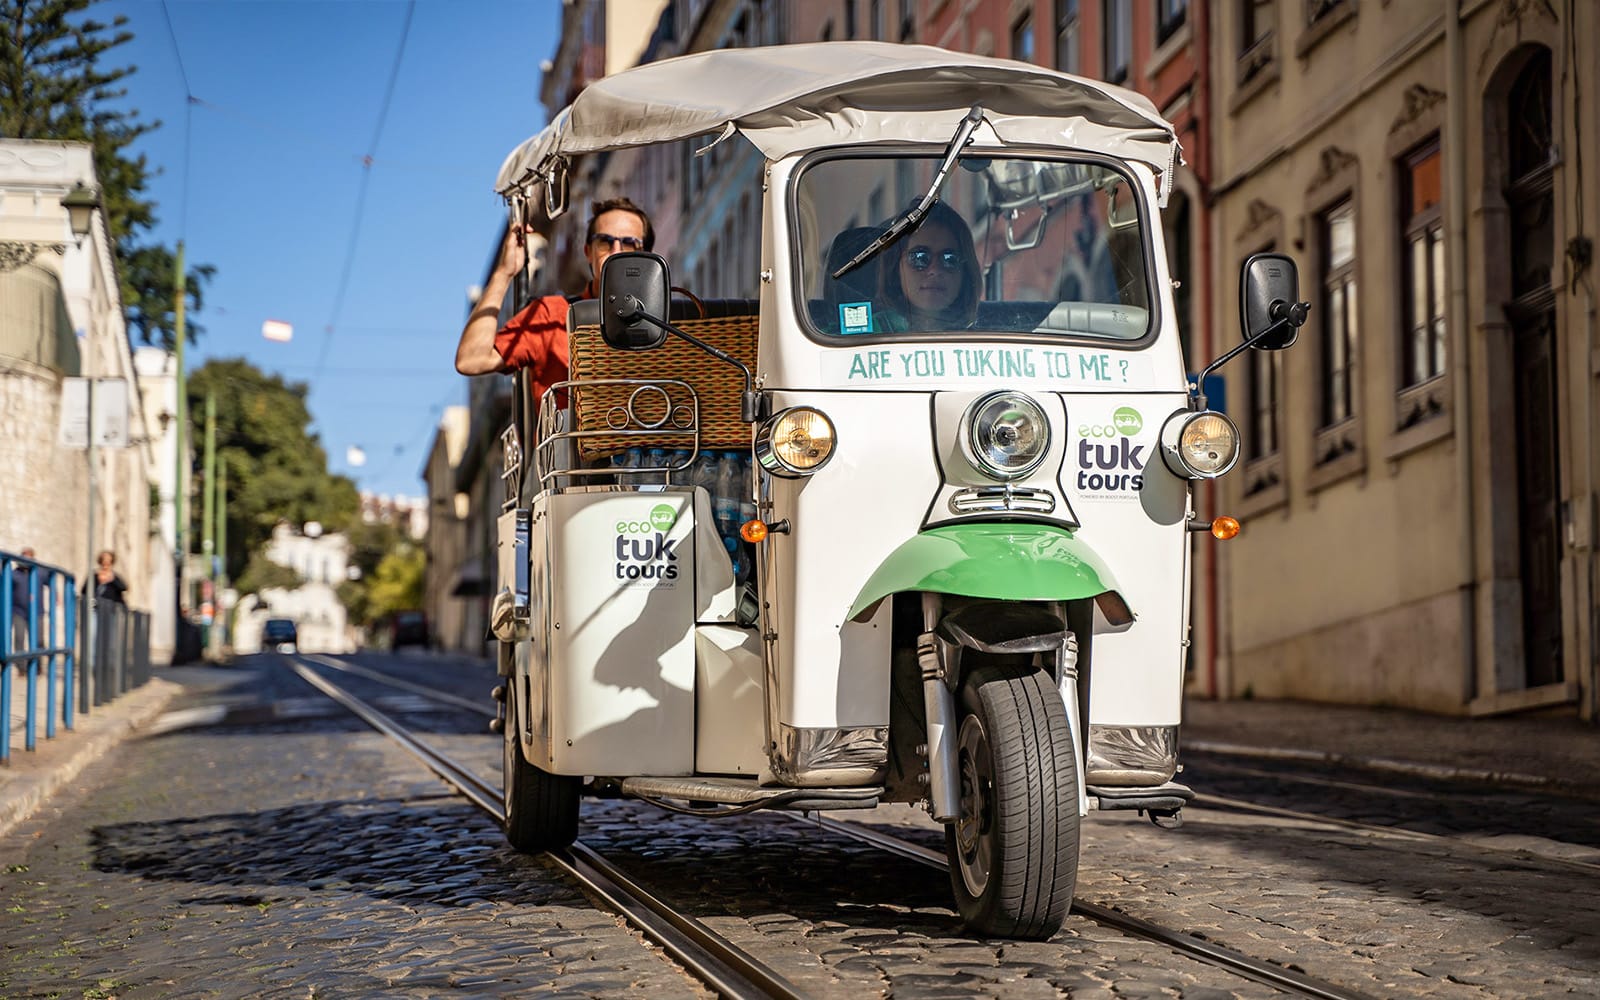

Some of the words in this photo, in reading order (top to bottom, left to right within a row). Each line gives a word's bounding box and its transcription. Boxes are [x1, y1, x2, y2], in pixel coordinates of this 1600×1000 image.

[848, 350, 891, 379] ARE
[899, 350, 945, 377] YOU
[953, 349, 1036, 378] TUKING
[1042, 351, 1071, 378] TO
[1079, 354, 1112, 381] ME
[1078, 424, 1116, 438] eco
[1078, 437, 1144, 470] tuk
[1077, 470, 1144, 491] tours
[616, 521, 651, 534] eco
[616, 532, 677, 561] tuk
[616, 562, 678, 580] tours
